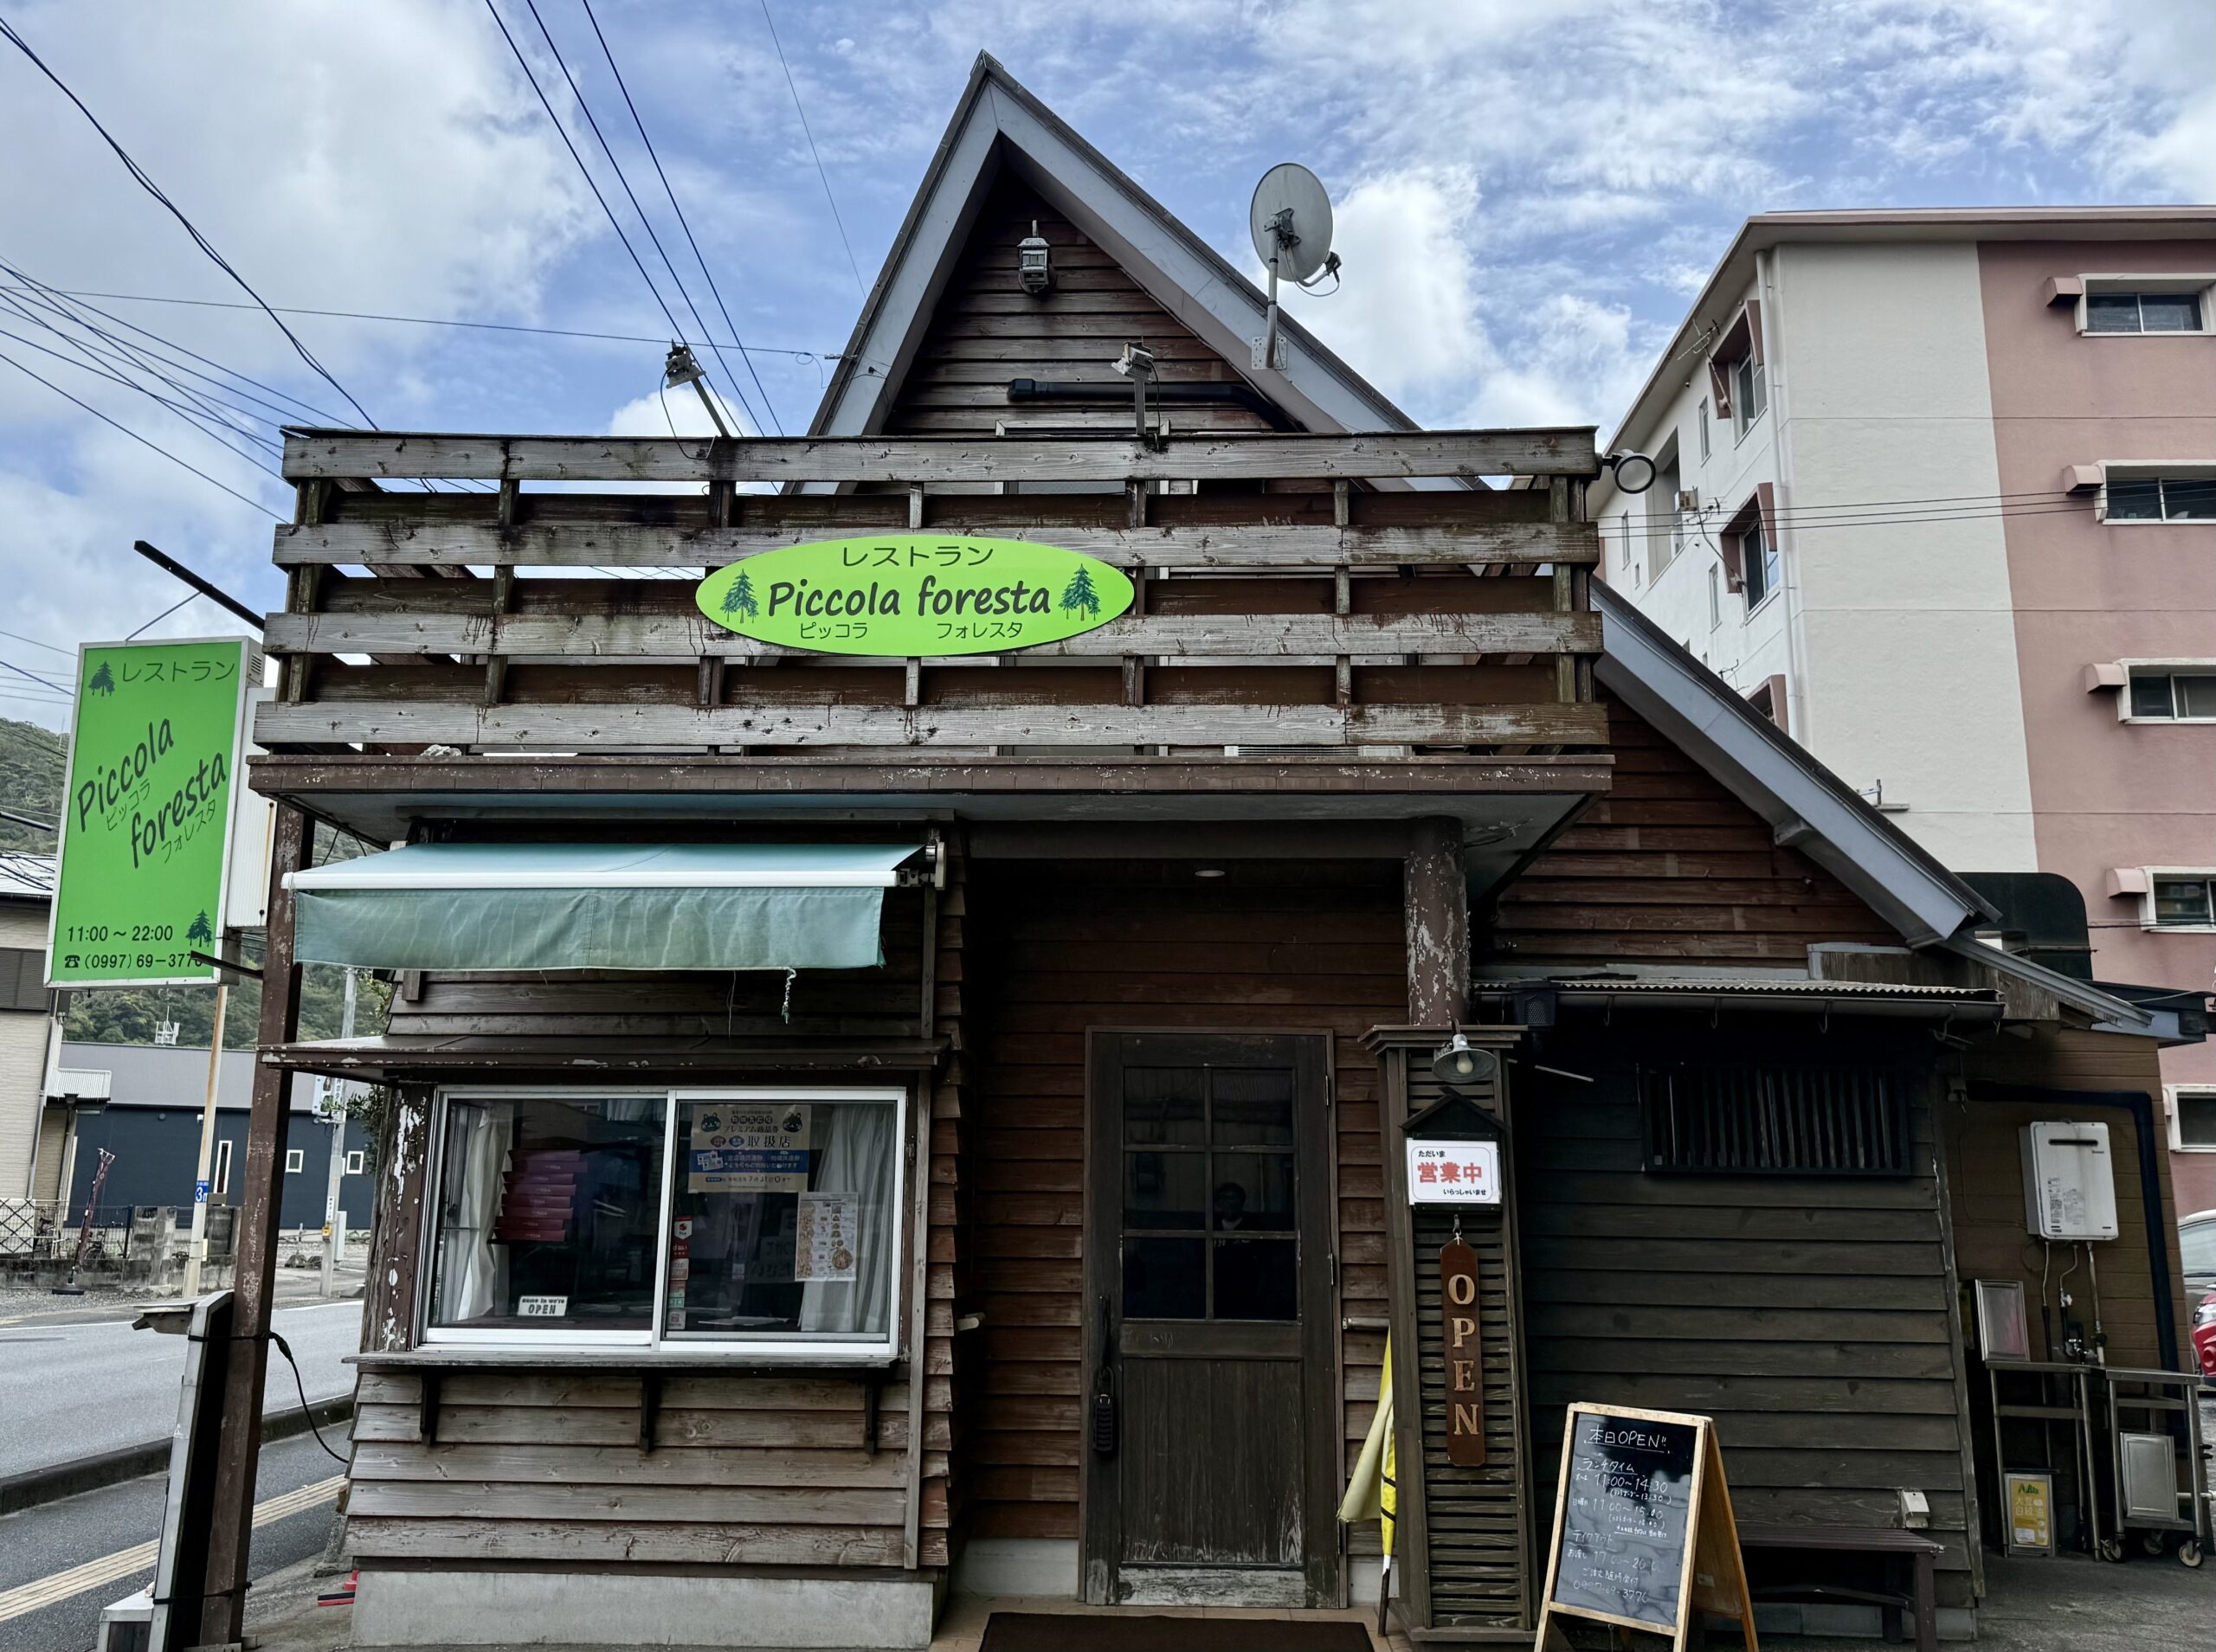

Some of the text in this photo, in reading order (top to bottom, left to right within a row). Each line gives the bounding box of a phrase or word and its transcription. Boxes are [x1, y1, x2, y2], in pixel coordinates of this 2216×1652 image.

[843, 546, 994, 568] レストラン
[769, 575, 1051, 617] Piccola foresta
[800, 621, 1023, 640] ピッコラ フォレスタ
[123, 661, 235, 682] レストラン
[78, 718, 174, 832] Piccola
[106, 778, 151, 832] ピッコラ
[132, 753, 227, 869] foresta
[161, 799, 216, 864] フォレスタ
[748, 1135, 791, 1147] 取扱店
[1417, 1162, 1482, 1184] 営業中
[528, 1304, 557, 1314] OPEN
[1448, 1274, 1478, 1435] OPEN
[1583, 1458, 1634, 1472] ランチタイム
